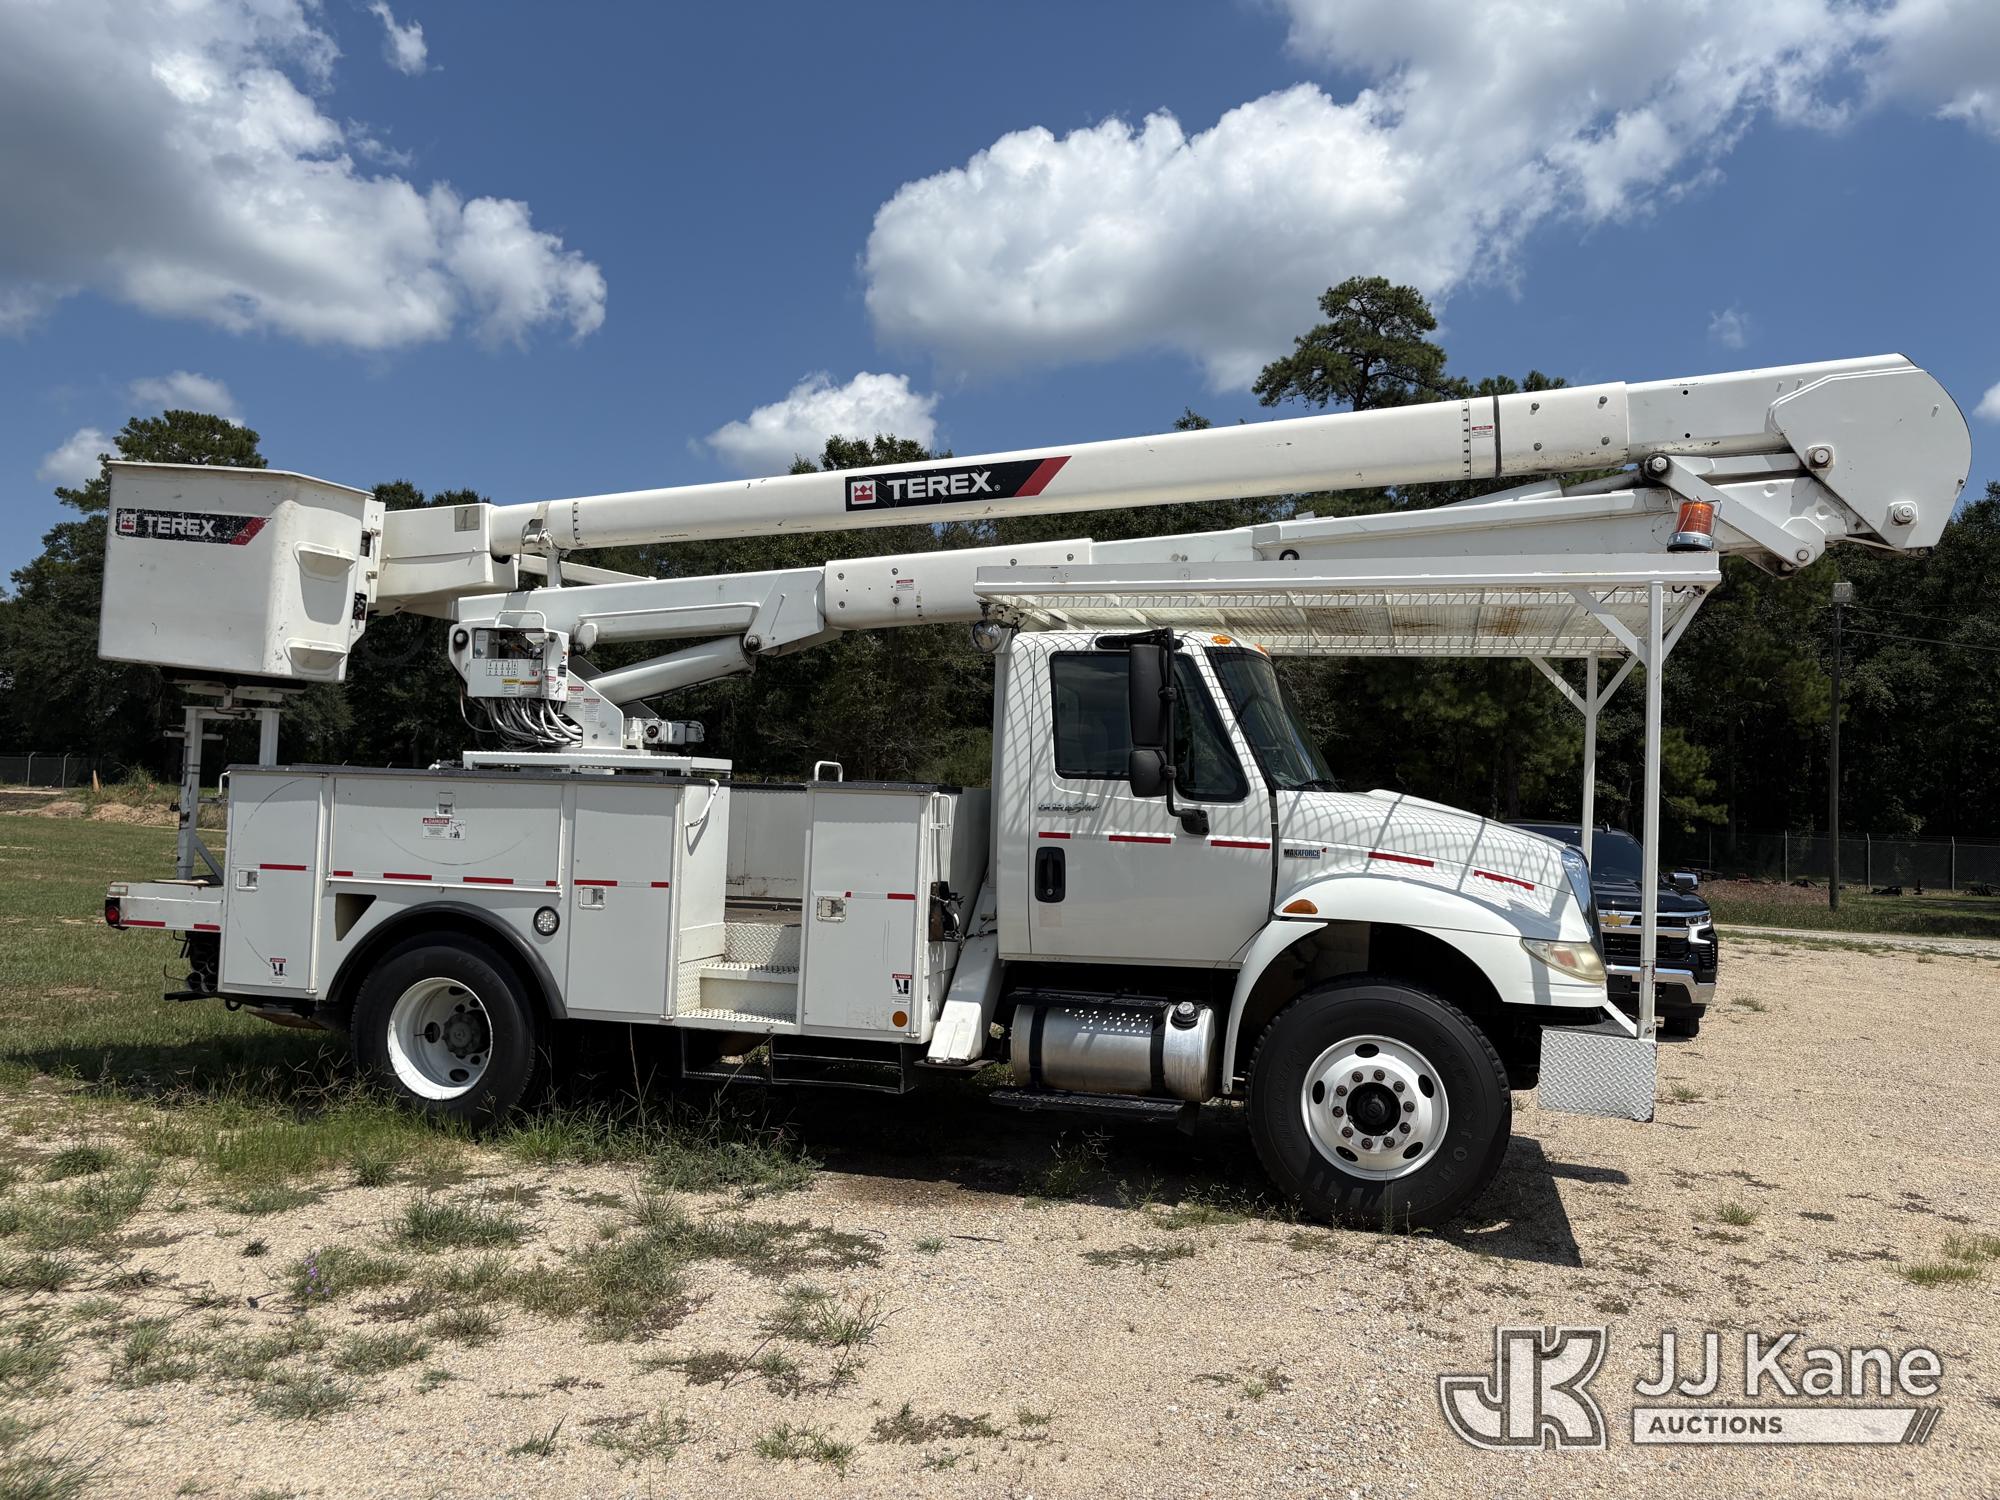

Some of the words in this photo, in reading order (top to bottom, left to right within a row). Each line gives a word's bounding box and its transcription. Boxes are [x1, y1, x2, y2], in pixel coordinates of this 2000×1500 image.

[887, 471, 993, 500] TEREX
[144, 515, 216, 537] TEREX
[1283, 848, 1321, 857] MAXXFORCE
